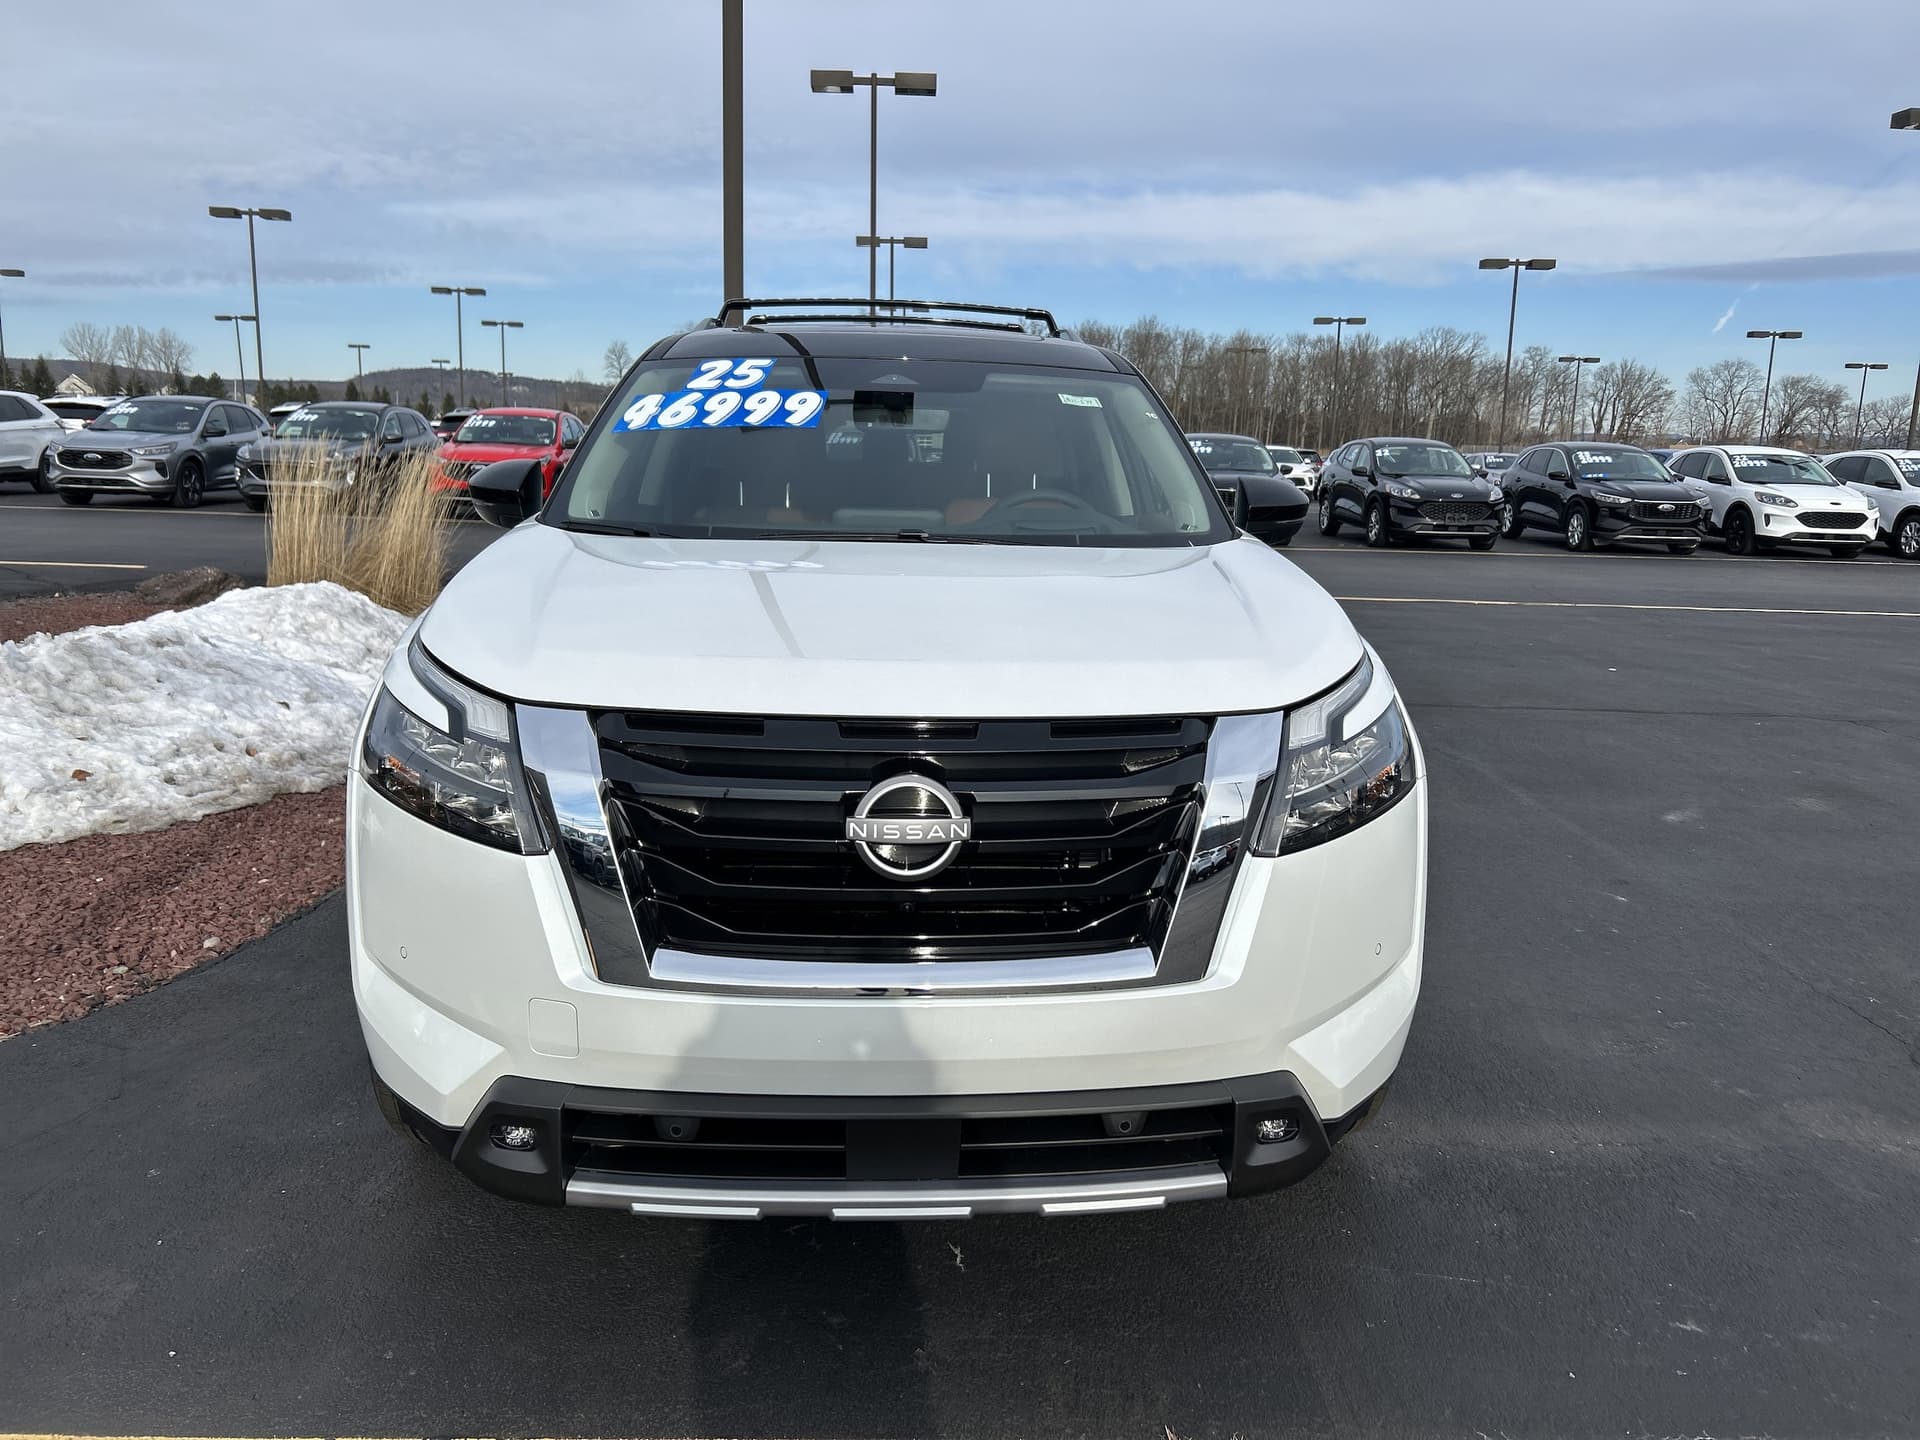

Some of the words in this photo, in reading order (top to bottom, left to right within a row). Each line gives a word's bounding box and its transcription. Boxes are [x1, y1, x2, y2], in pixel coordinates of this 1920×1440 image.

[686, 359, 774, 390] 25
[623, 391, 823, 430] 46999
[849, 822, 968, 840] NISSAN
